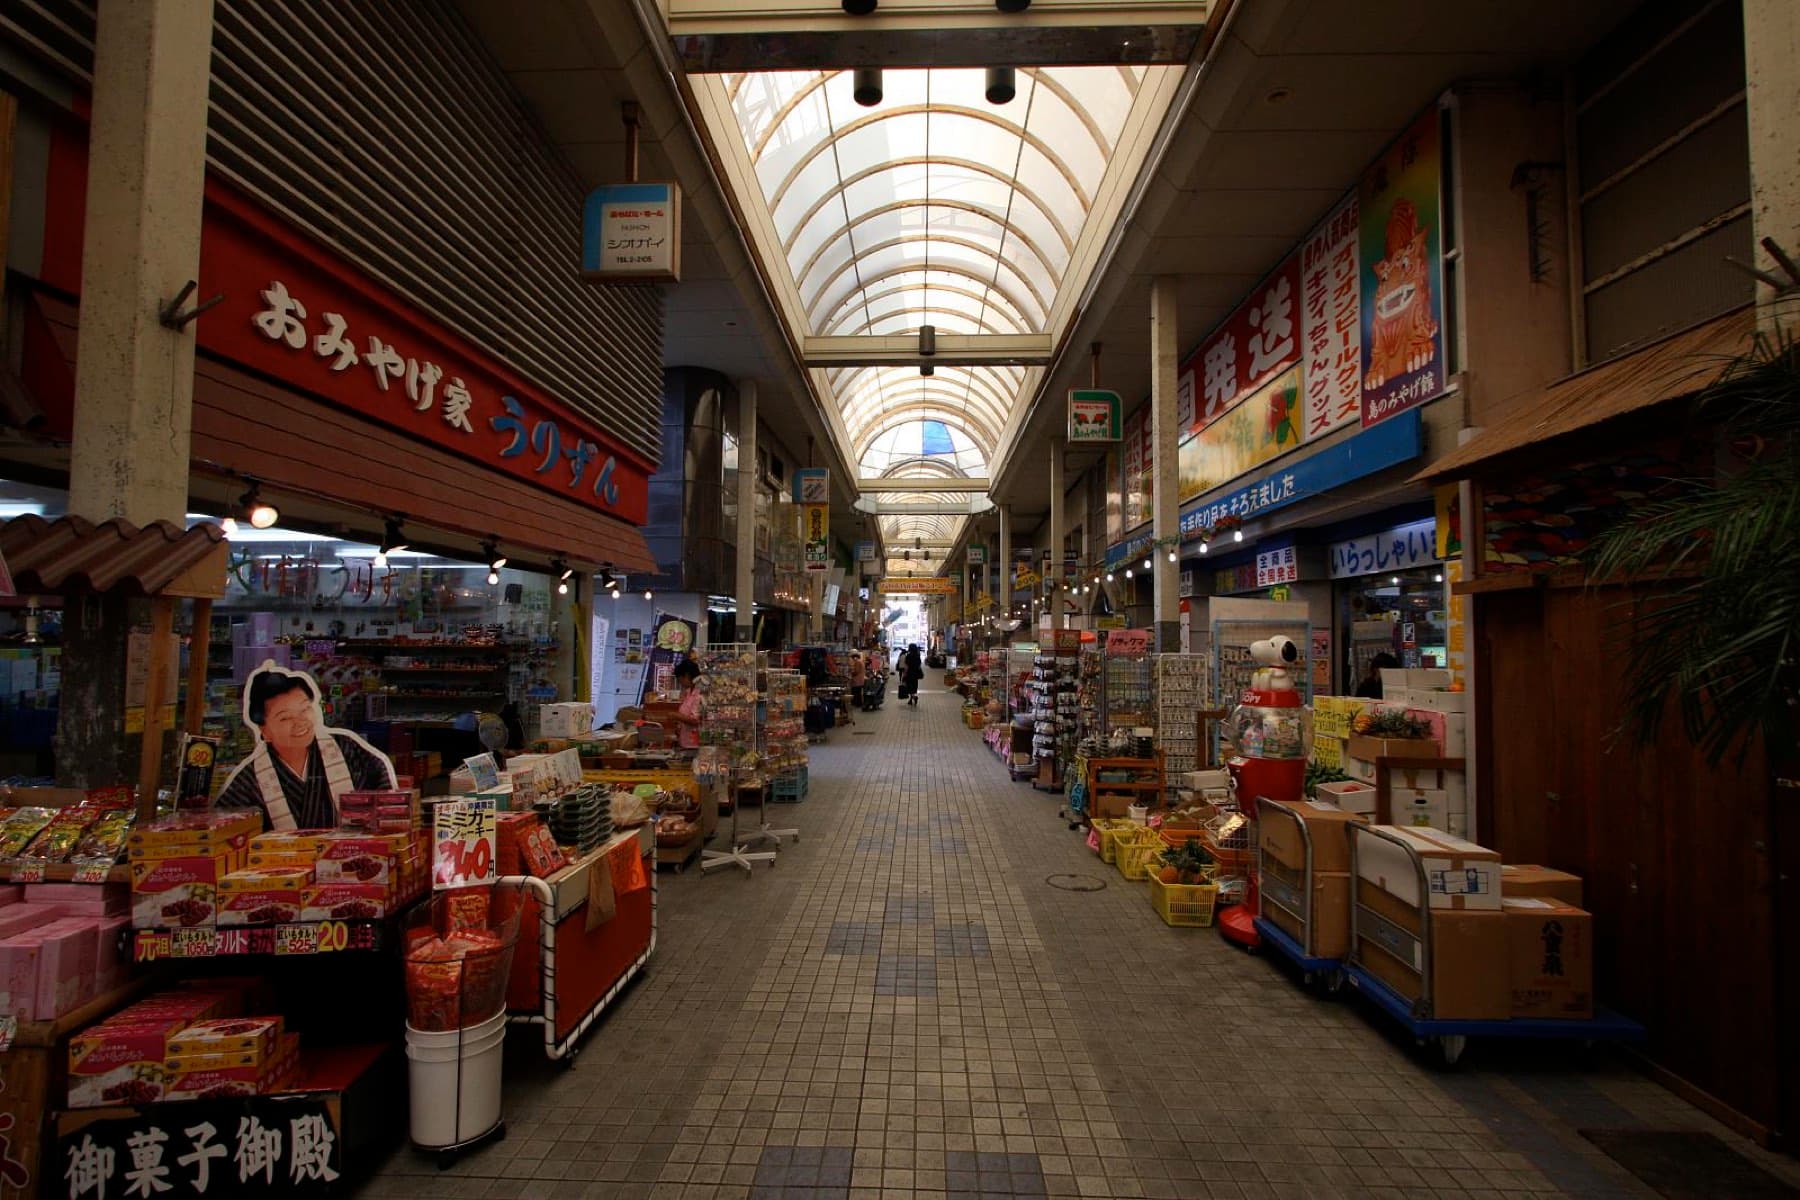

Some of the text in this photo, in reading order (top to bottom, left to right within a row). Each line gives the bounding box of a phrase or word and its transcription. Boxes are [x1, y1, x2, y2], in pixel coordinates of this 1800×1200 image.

[251, 280, 620, 506] おみやげ家 うりずん
[1306, 267, 1330, 436] キティちゃんグッズ
[437, 811, 494, 828] ミミガー
[137, 929, 169, 962] 元祖
[63, 1112, 341, 1200] 御菓子御殿
